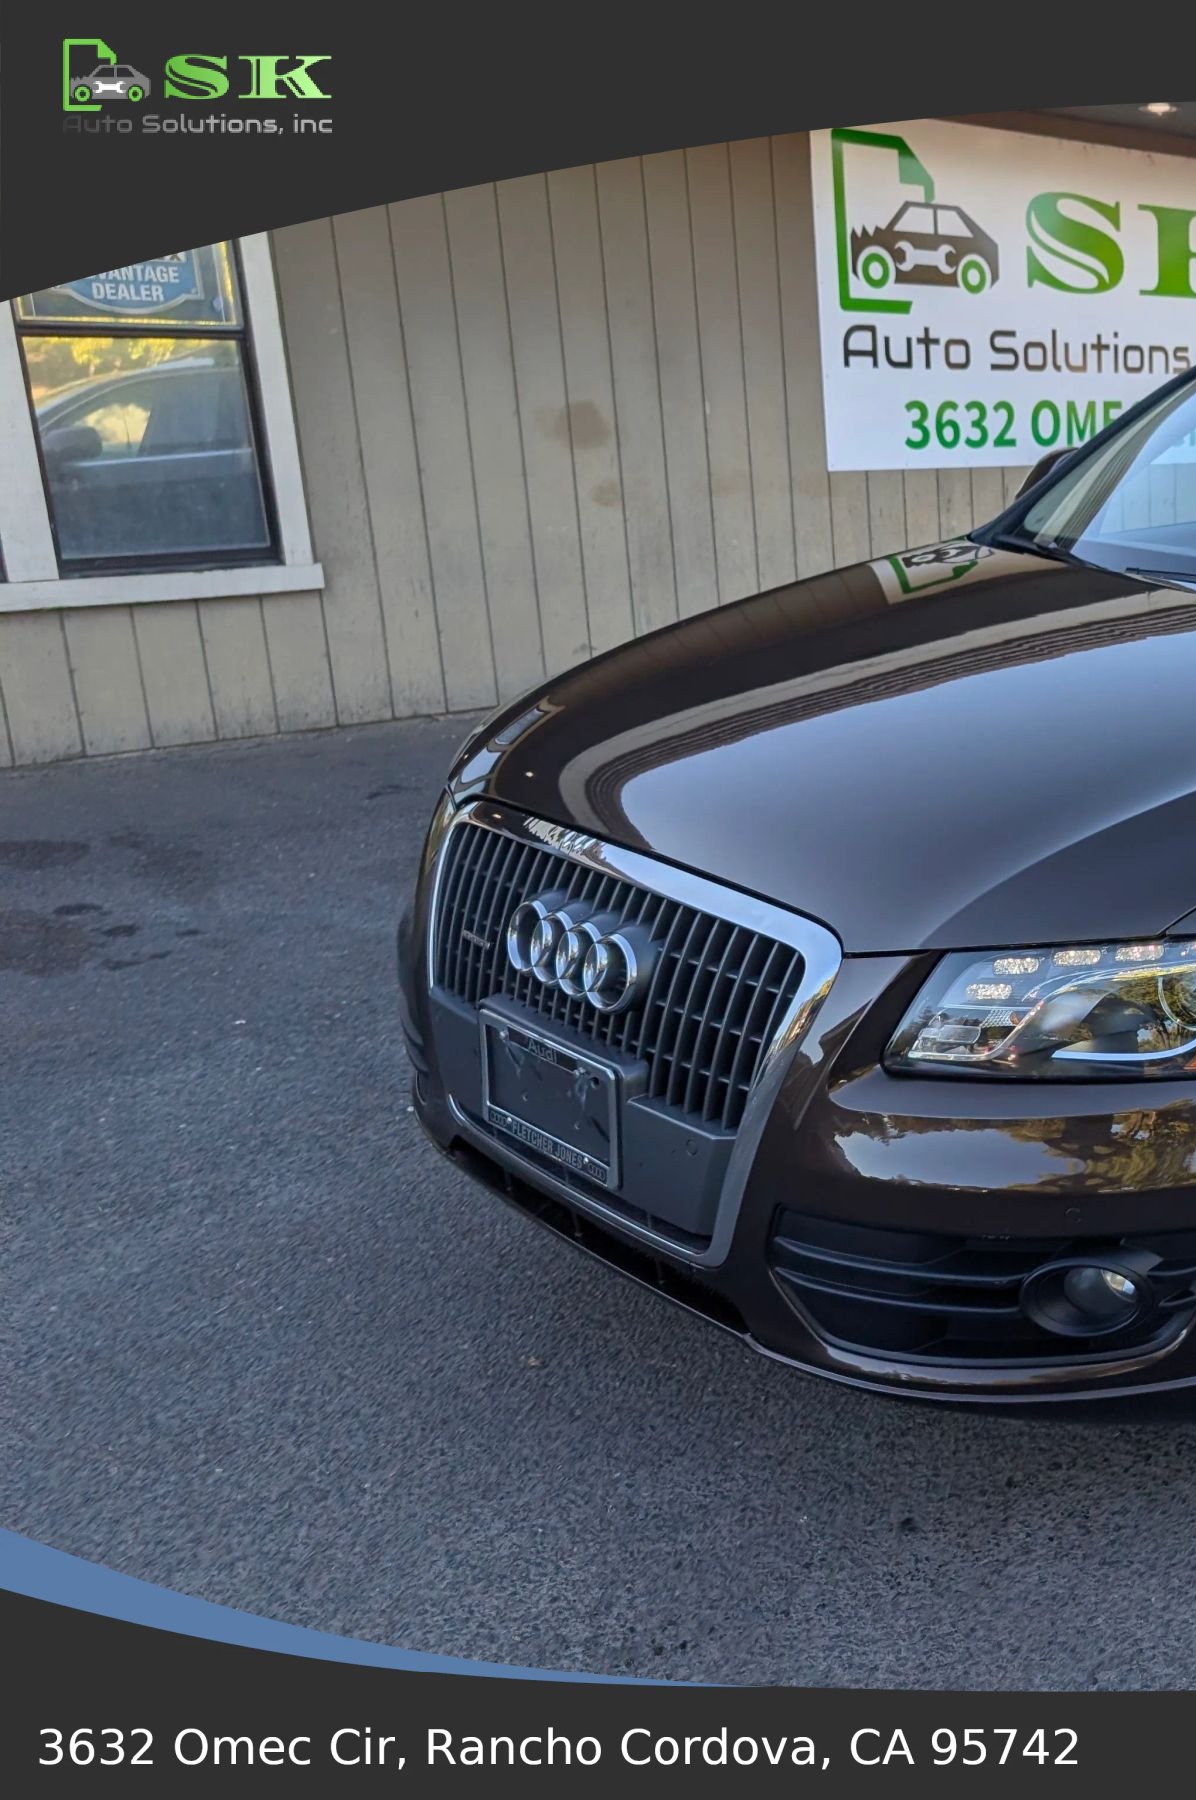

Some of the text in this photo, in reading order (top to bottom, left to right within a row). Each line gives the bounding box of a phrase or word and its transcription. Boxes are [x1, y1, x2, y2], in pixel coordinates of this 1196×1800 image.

[85, 264, 180, 284] ANTAGE
[92, 281, 165, 302] DEALER
[842, 324, 972, 371] Auto
[904, 399, 1017, 450] 3632
[1031, 399, 1124, 448] OME
[528, 1038, 558, 1065] Audi
[512, 1120, 583, 1169] FLETCHER JONES
